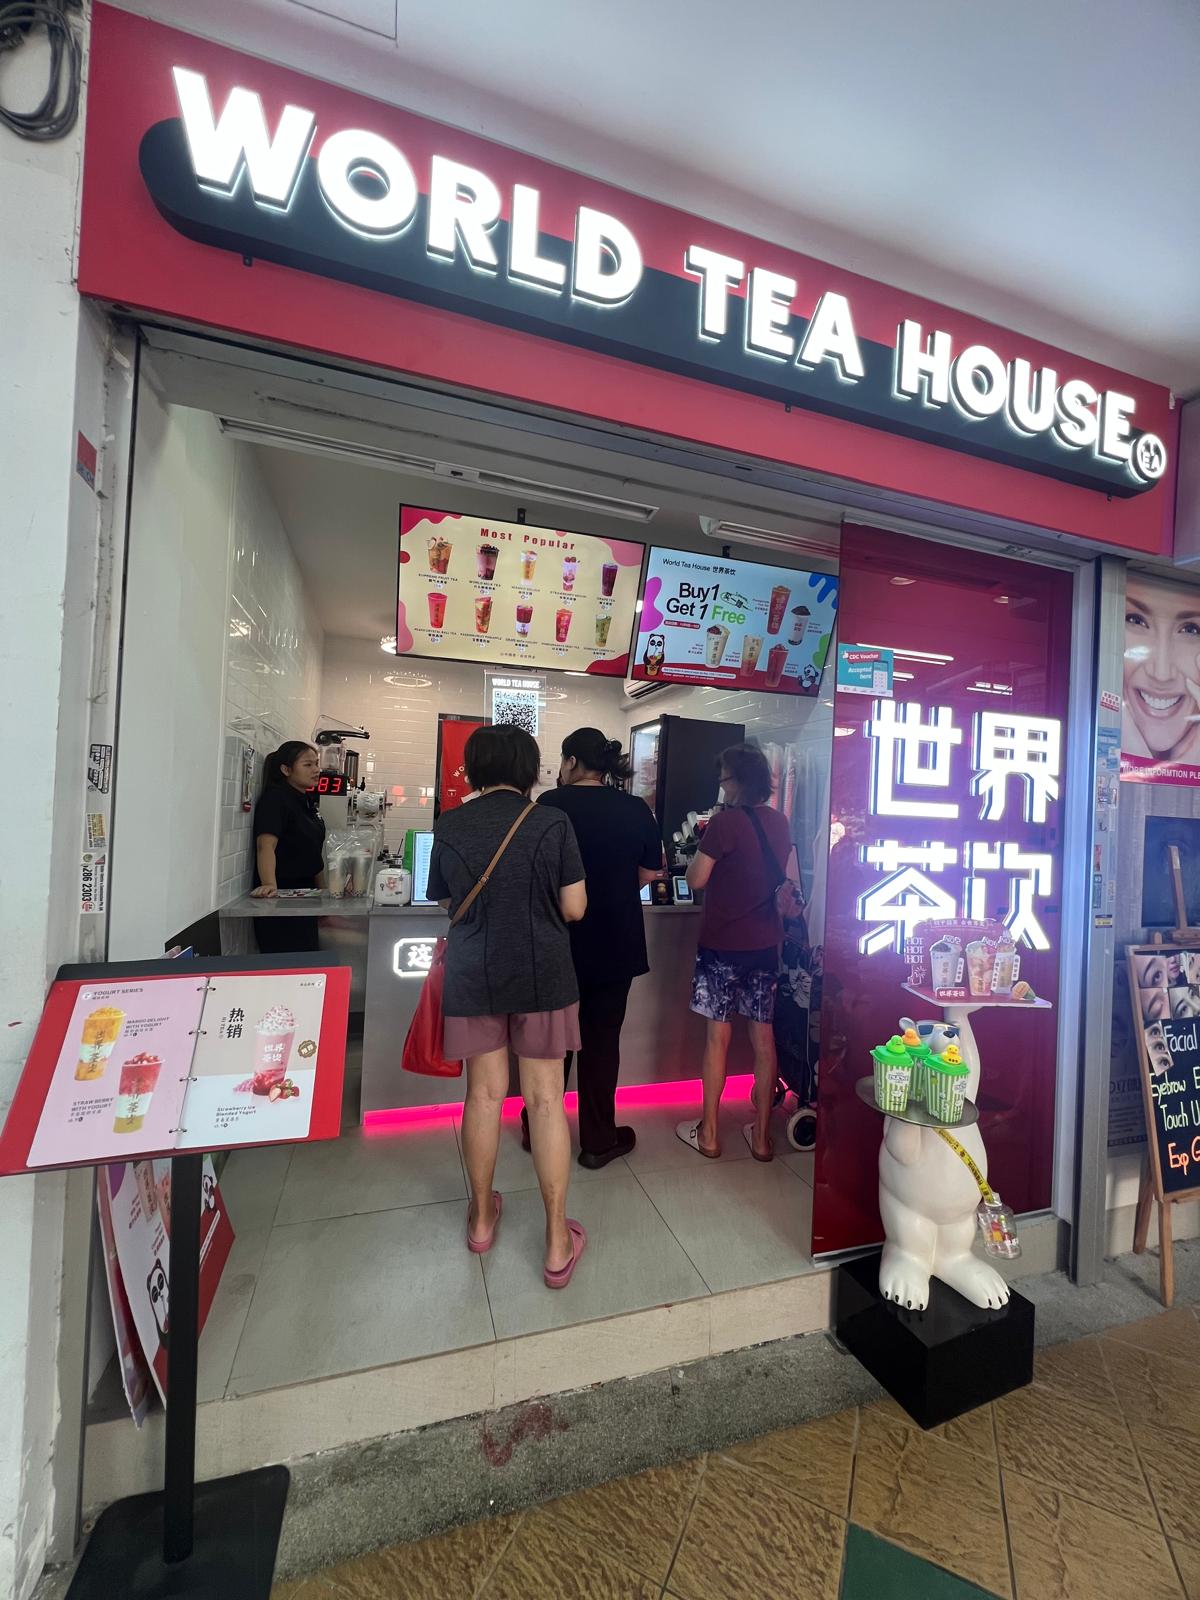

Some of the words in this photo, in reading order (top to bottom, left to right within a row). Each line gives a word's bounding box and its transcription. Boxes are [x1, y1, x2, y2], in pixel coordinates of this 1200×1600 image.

[172, 65, 643, 305] WORLD
[684, 245, 864, 381] TEA
[894, 319, 1136, 464] HOUSE
[480, 528, 512, 540] Most
[523, 535, 575, 550] Popular
[662, 558, 681, 568] World
[682, 562, 693, 570] Tea
[693, 563, 711, 572] House
[712, 565, 737, 577] 世界茶饮
[666, 597, 697, 618] Get
[699, 603, 709, 620] 1
[711, 605, 747, 624] Free
[848, 653, 860, 661] CDC
[491, 678, 511, 687] WORLD
[511, 679, 522, 688] TEA
[863, 699, 1061, 823] 世界
[304, 777, 343, 793] 83
[227, 1007, 245, 1039] 热销
[1163, 1023, 1198, 1054] Facial
[1149, 1071, 1187, 1106] Eyebrow
[1160, 1102, 1189, 1133] Touch
[1167, 1143, 1190, 1176] Exp
